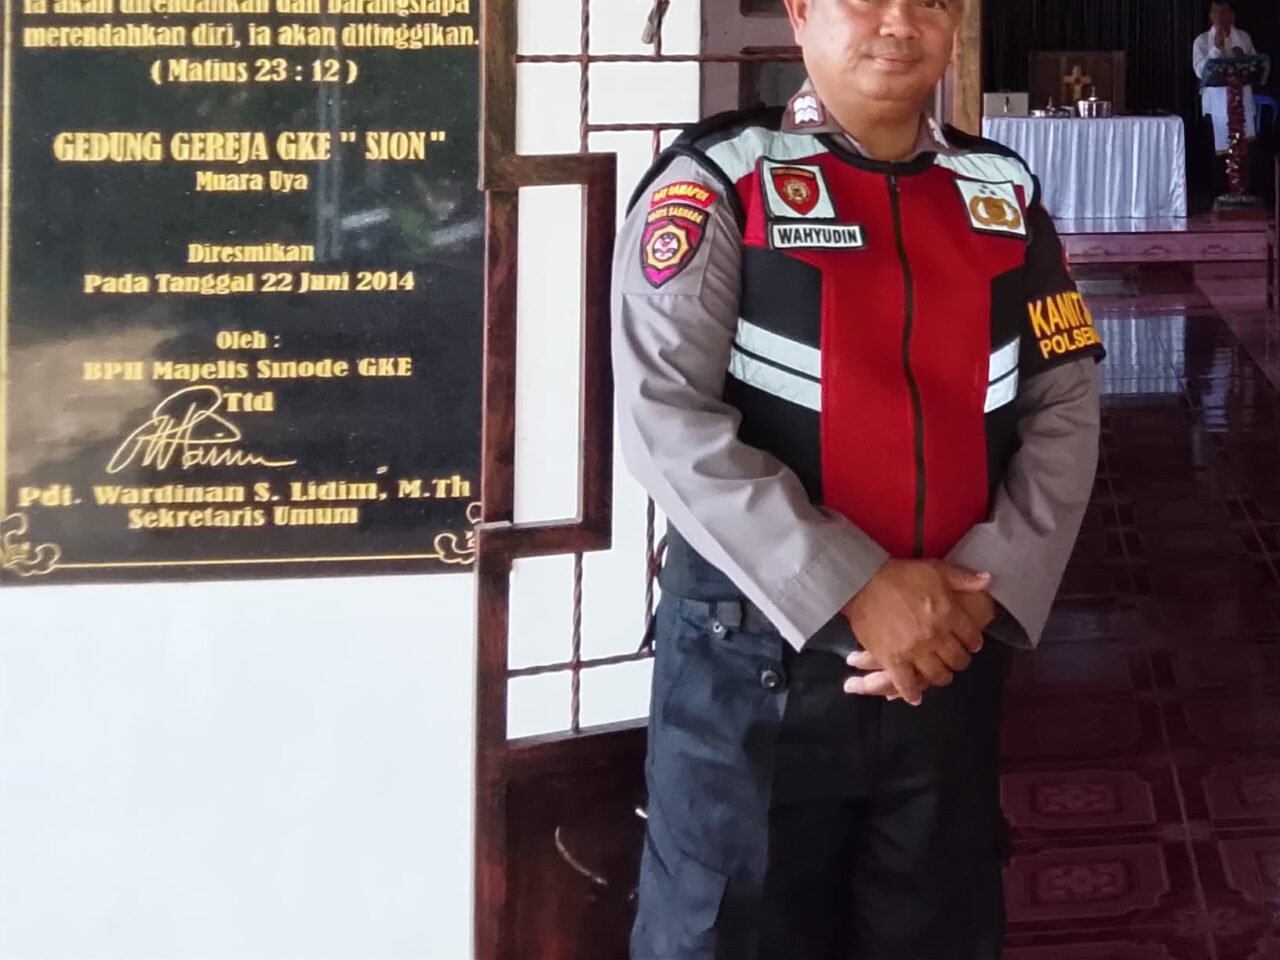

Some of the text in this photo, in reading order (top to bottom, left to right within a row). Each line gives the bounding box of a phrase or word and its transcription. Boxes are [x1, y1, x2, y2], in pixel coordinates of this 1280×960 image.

[22, 23, 480, 49] merendahkan diri, ia akan ditinggikan.
[167, 58, 249, 82] Matius
[254, 58, 288, 82] 23
[312, 58, 340, 82] 12
[53, 131, 163, 162] GEDUNG
[170, 131, 269, 164] GEREJA
[276, 131, 331, 161] GKE
[195, 170, 309, 192] Muara Uya
[778, 227, 859, 245] WAHYUDIN
[187, 243, 314, 263] Diresmikan
[83, 270, 415, 295] Pada Tanggal 22 Juni 2014
[215, 330, 267, 350] Oleh
[82, 357, 413, 382] BPH Majelis Sinode GKE
[222, 391, 275, 413] Ttd
[18, 483, 83, 507] Pdt.
[92, 483, 245, 505] Wardinan
[253, 481, 280, 502] S.
[397, 474, 472, 499] M.Th
[128, 505, 359, 530] Sekretaris Umum
